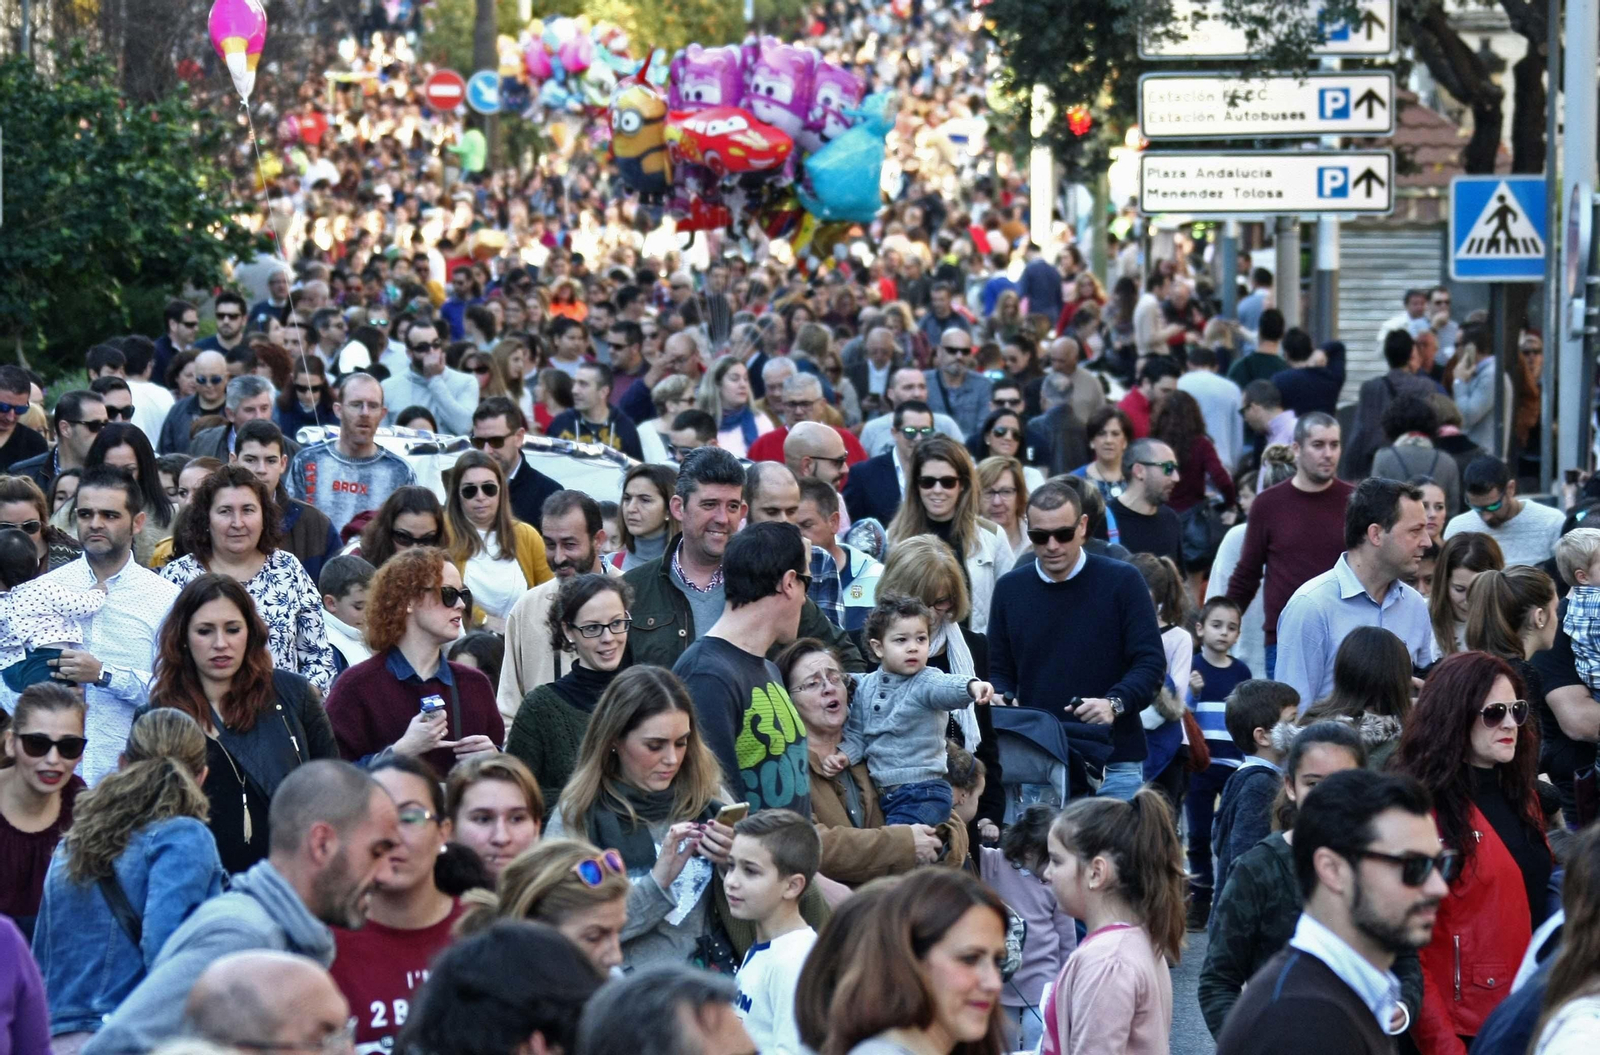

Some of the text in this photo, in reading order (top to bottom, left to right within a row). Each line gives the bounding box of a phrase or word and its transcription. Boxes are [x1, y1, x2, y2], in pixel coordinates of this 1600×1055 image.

[1325, 89, 1346, 119] P
[1148, 109, 1307, 123] Estación Autobuses
[1147, 166, 1187, 179] Plaza
[1323, 168, 1345, 198] P
[1233, 186, 1284, 199] Tolosa
[332, 479, 368, 496] BROX
